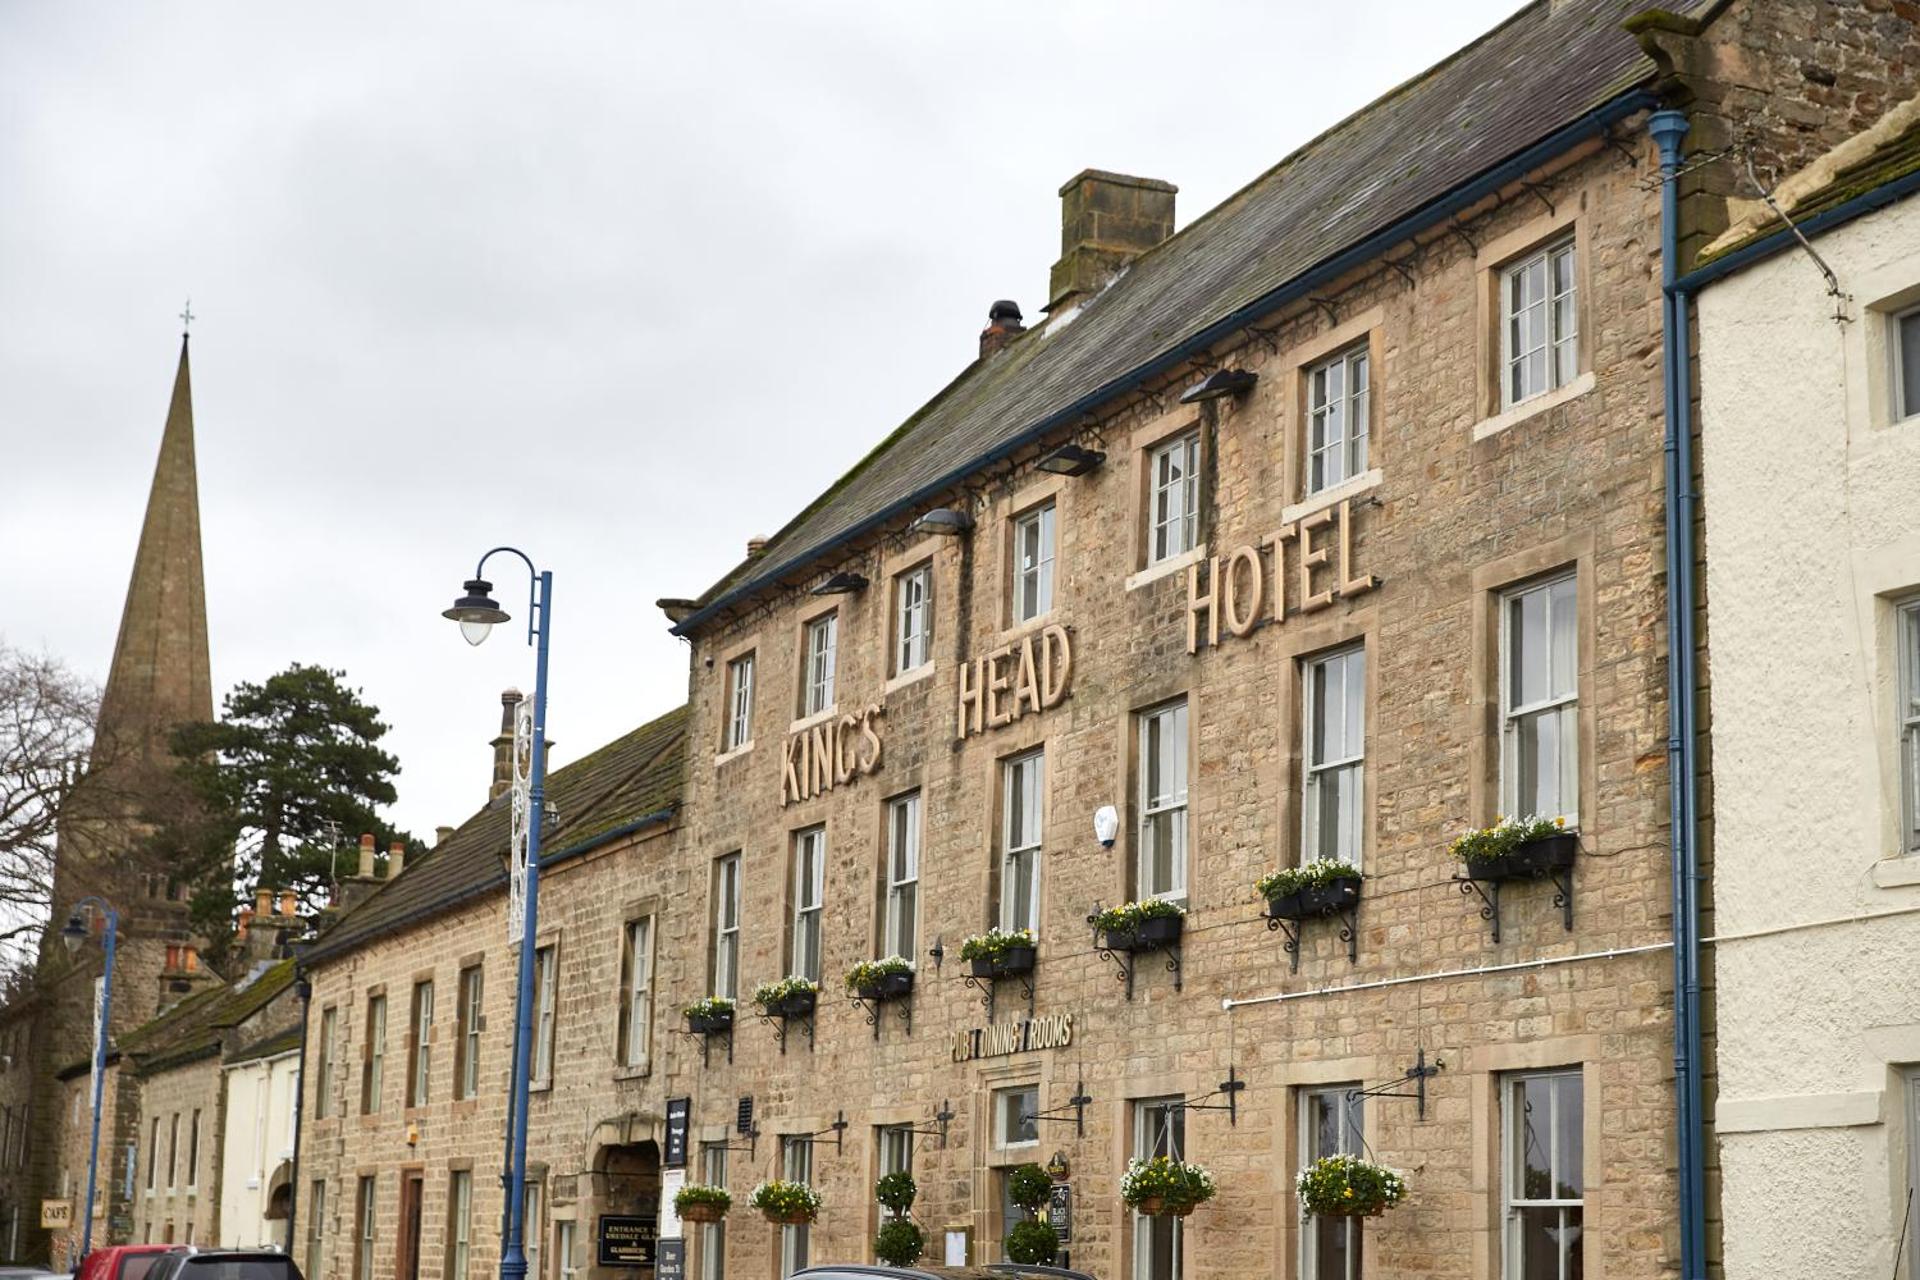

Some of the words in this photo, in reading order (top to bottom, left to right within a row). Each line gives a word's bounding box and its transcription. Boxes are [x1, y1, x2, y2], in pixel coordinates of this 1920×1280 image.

[957, 624, 1071, 739] HEAD
[1187, 500, 1372, 655] HOTEL
[950, 1031, 971, 1062] PUB
[981, 1021, 1019, 1057] DINING
[1028, 1013, 1072, 1051] ROOMS
